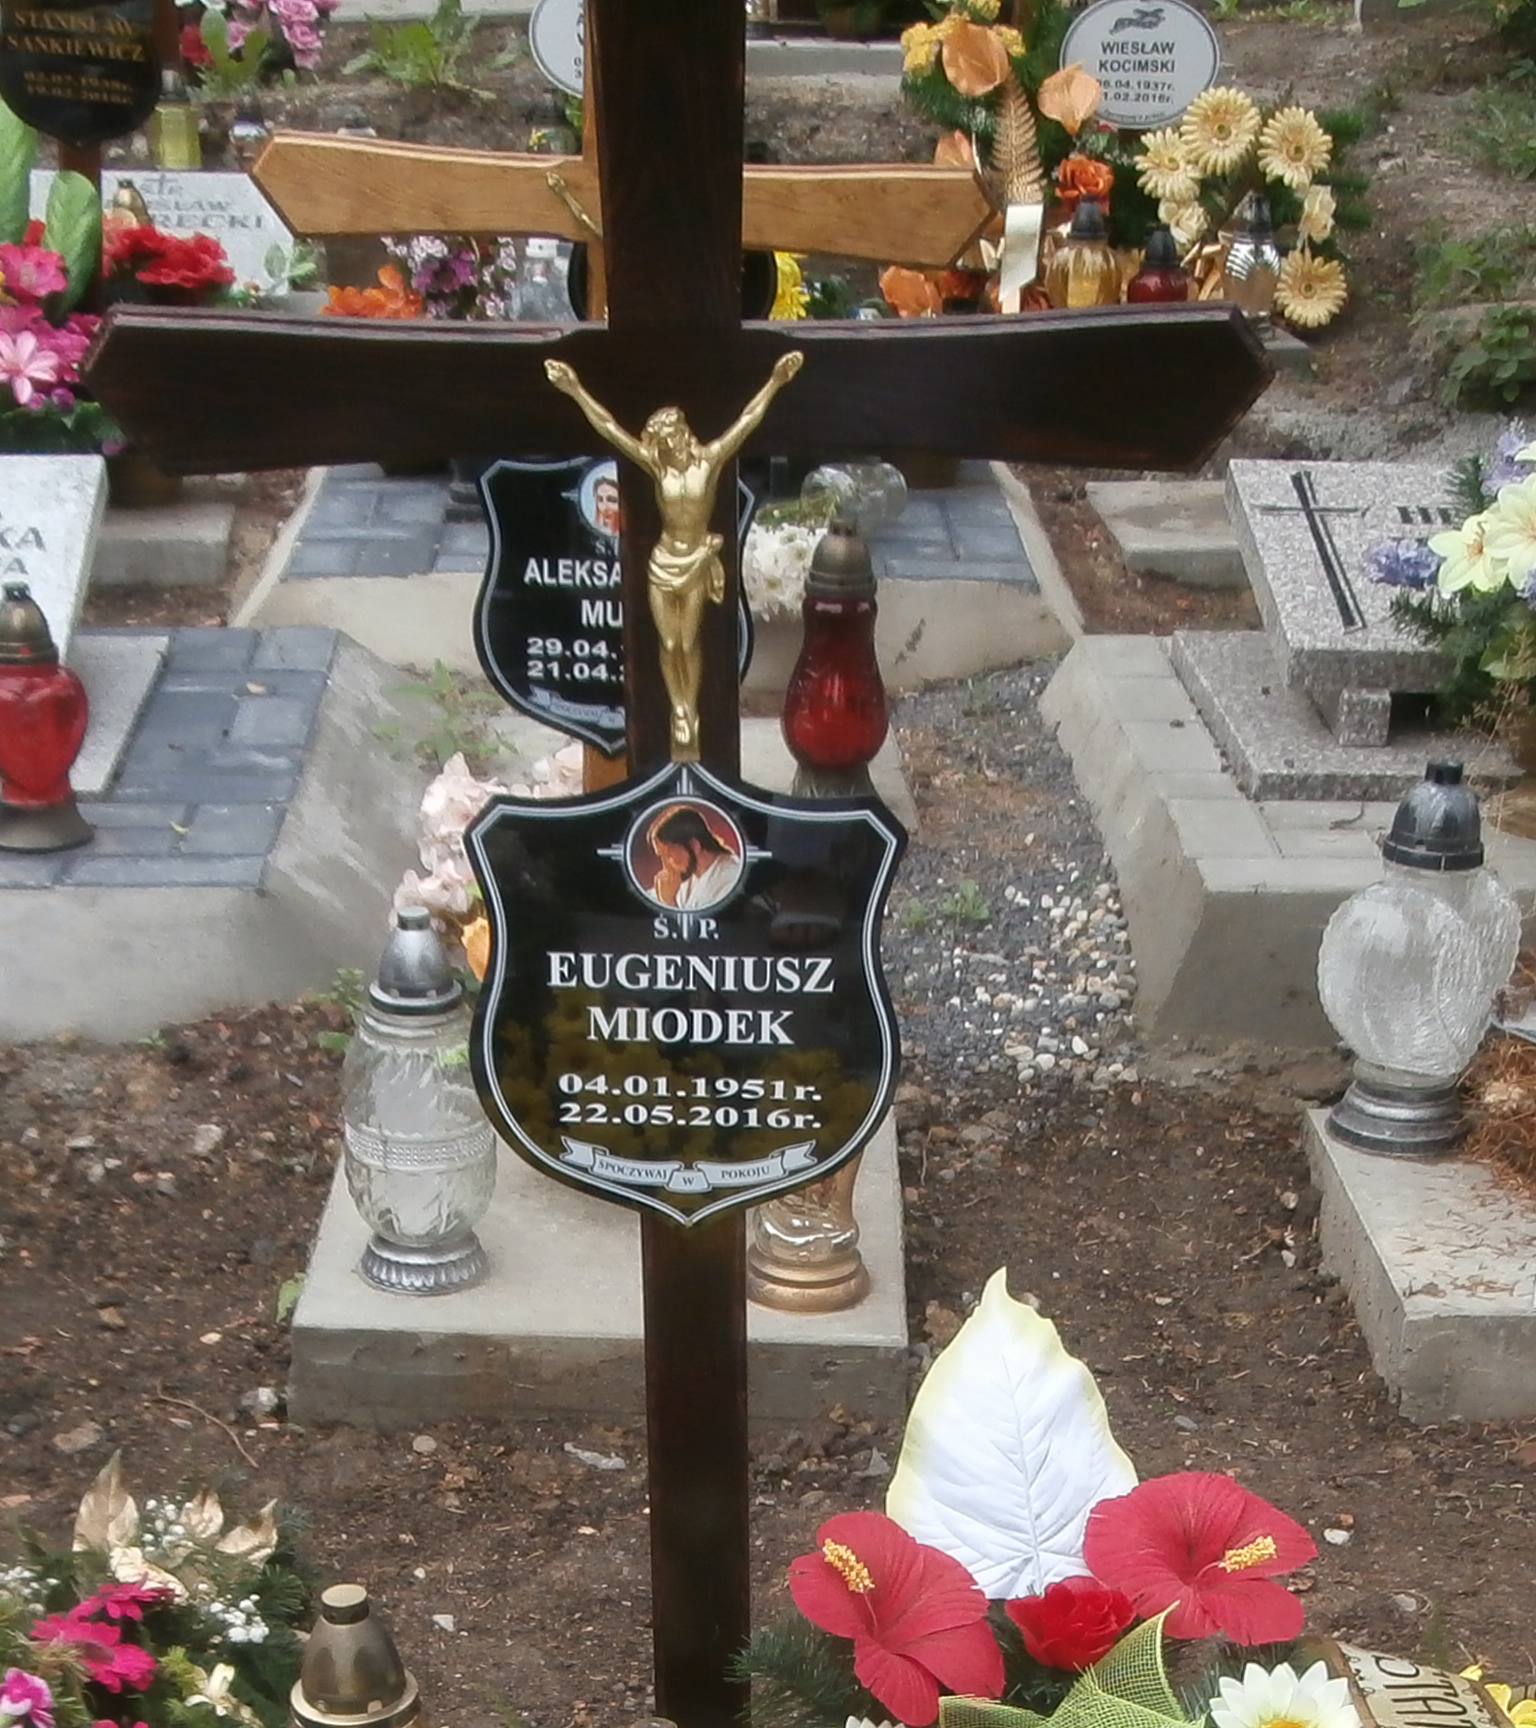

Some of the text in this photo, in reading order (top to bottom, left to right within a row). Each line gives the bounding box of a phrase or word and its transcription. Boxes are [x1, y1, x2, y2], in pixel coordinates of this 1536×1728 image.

[1101, 41, 1175, 55] WIESŁAW
[1098, 60, 1175, 73] KOCIMSKI
[526, 636, 625, 661] 29.04.
[546, 951, 836, 994] EUGENIUSZ
[586, 1006, 795, 1046] MIODEK
[558, 1073, 823, 1102] 04.01.1951r.
[558, 1103, 823, 1130] 22.05.2016r.
[719, 1164, 772, 1181] POKOJU
